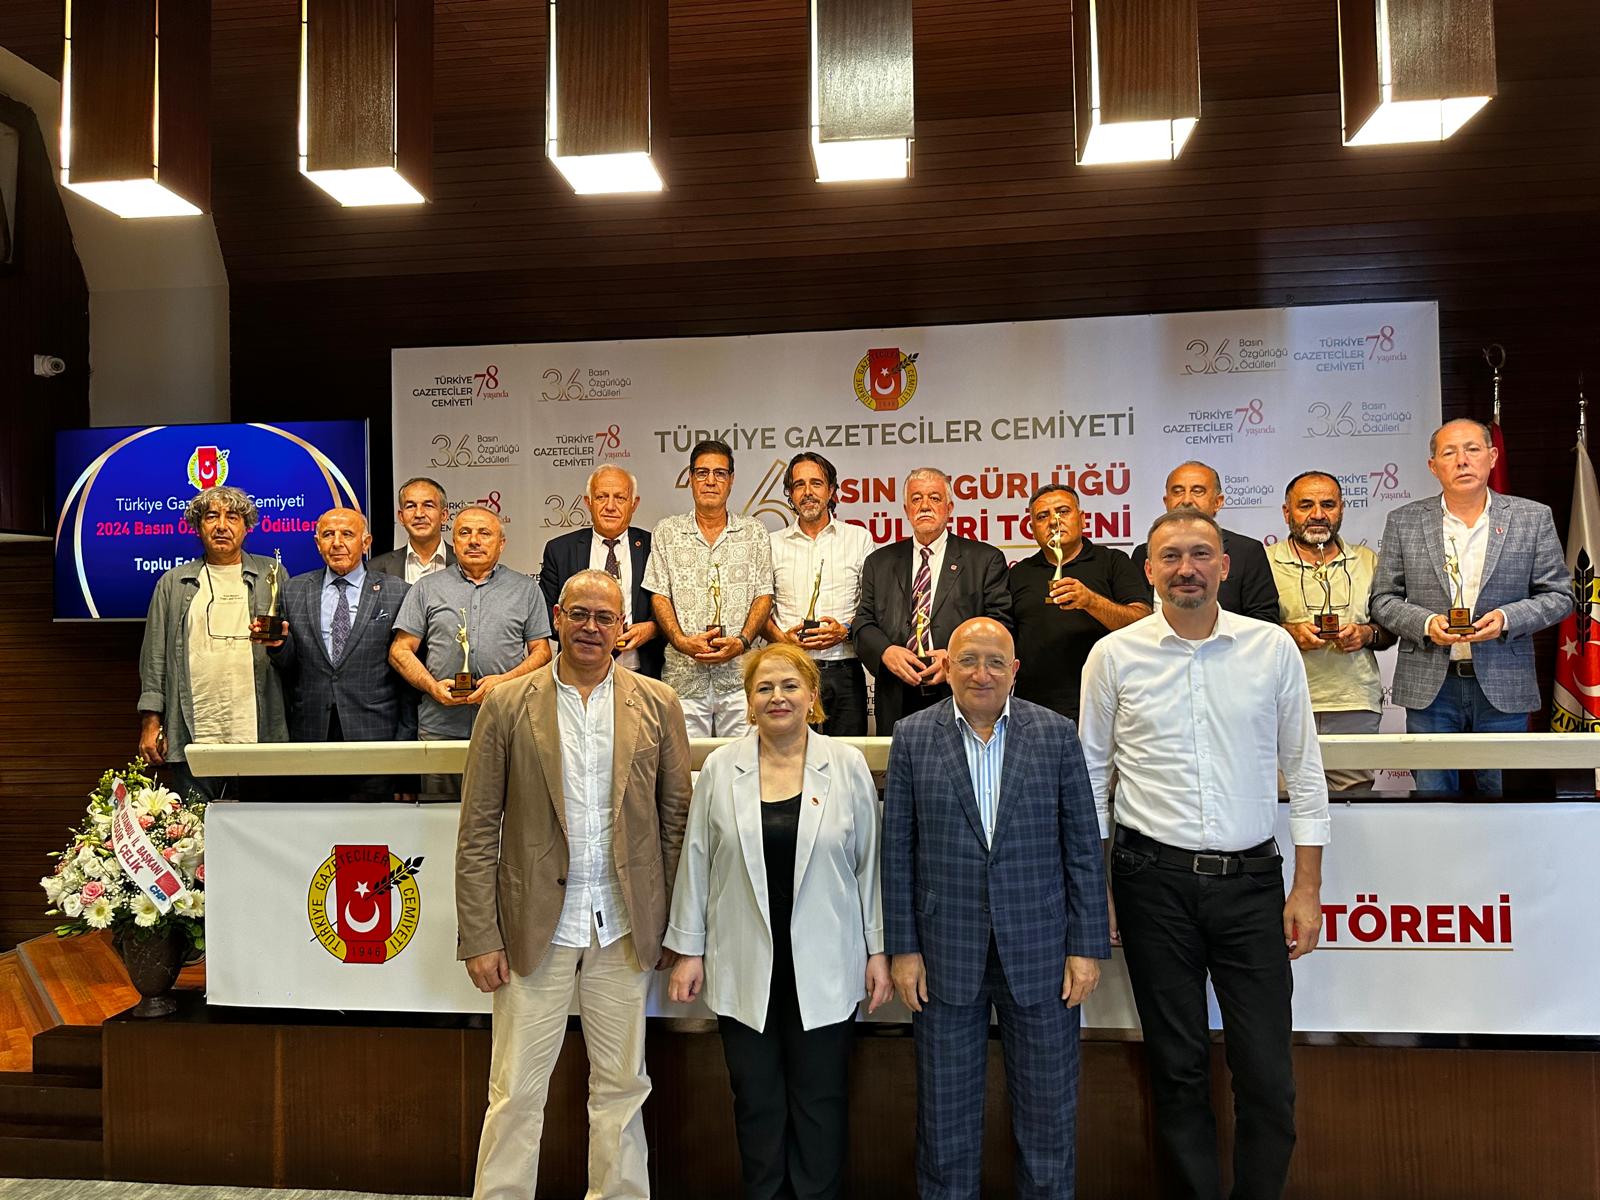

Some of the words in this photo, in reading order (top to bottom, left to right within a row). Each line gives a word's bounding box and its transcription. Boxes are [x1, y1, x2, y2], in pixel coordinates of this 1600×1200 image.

[1240, 339, 1263, 347] Basın
[1320, 337, 1364, 347] TÜRKİYE
[1366, 326, 1394, 360] 78
[1240, 348, 1288, 359] Özgürlüğü
[1294, 349, 1364, 361] GAZETECİLER
[1377, 351, 1407, 362] yaşında
[1240, 359, 1276, 369] Ödülleri
[1316, 361, 1364, 372] CEMİYETİ
[435, 375, 472, 385] TÜRKİYE
[473, 365, 499, 397] 78
[589, 377, 631, 387] Özgürlüğü
[413, 387, 473, 396] GAZETECİLER
[483, 390, 508, 400] yaşında
[589, 388, 621, 397] Ödülleri
[432, 397, 473, 407] CEMİYETİ
[1189, 410, 1233, 420] TÜRKİYE
[1234, 399, 1264, 433] 78
[1362, 411, 1411, 422] Özgürlüğü
[784, 420, 983, 448] GAZETECİLER
[991, 406, 1135, 441] CEMİYETİ
[1163, 422, 1233, 433] GAZETECİLER
[1245, 424, 1276, 436] yaşında
[1362, 422, 1400, 433] Ödülleri
[556, 434, 594, 444] TÜRKİYE
[595, 424, 620, 457] 78
[1186, 434, 1233, 444] CEMİYETİ
[477, 444, 519, 453] Özgürlüğü
[534, 446, 594, 456] GAZETECİLER
[477, 454, 510, 464] Ödülleri
[604, 450, 631, 459] yaşında
[553, 457, 594, 467] CEMİYETİ
[1225, 475, 1249, 483] Basın
[1336, 473, 1368, 484] RKİYE
[1369, 463, 1399, 498] 78
[1225, 485, 1274, 496] Özgürlüğü
[1380, 489, 1411, 500] yaşında
[116, 497, 163, 514] Türkiye
[1225, 496, 1262, 506] Ödülleri
[96, 522, 130, 536] 2024
[134, 521, 174, 535] Basın
[262, 516, 317, 532] Ödüller
[134, 558, 171, 573] Toplu
[119, 843, 143, 874] ÇELİK
[136, 845, 164, 876] BAŞKANI
[150, 884, 168, 902] CHP
[311, 899, 340, 952] TÜRKİYE
[392, 888, 417, 953] CEMİYETİ
[1321, 894, 1512, 942] TÖRENİ
